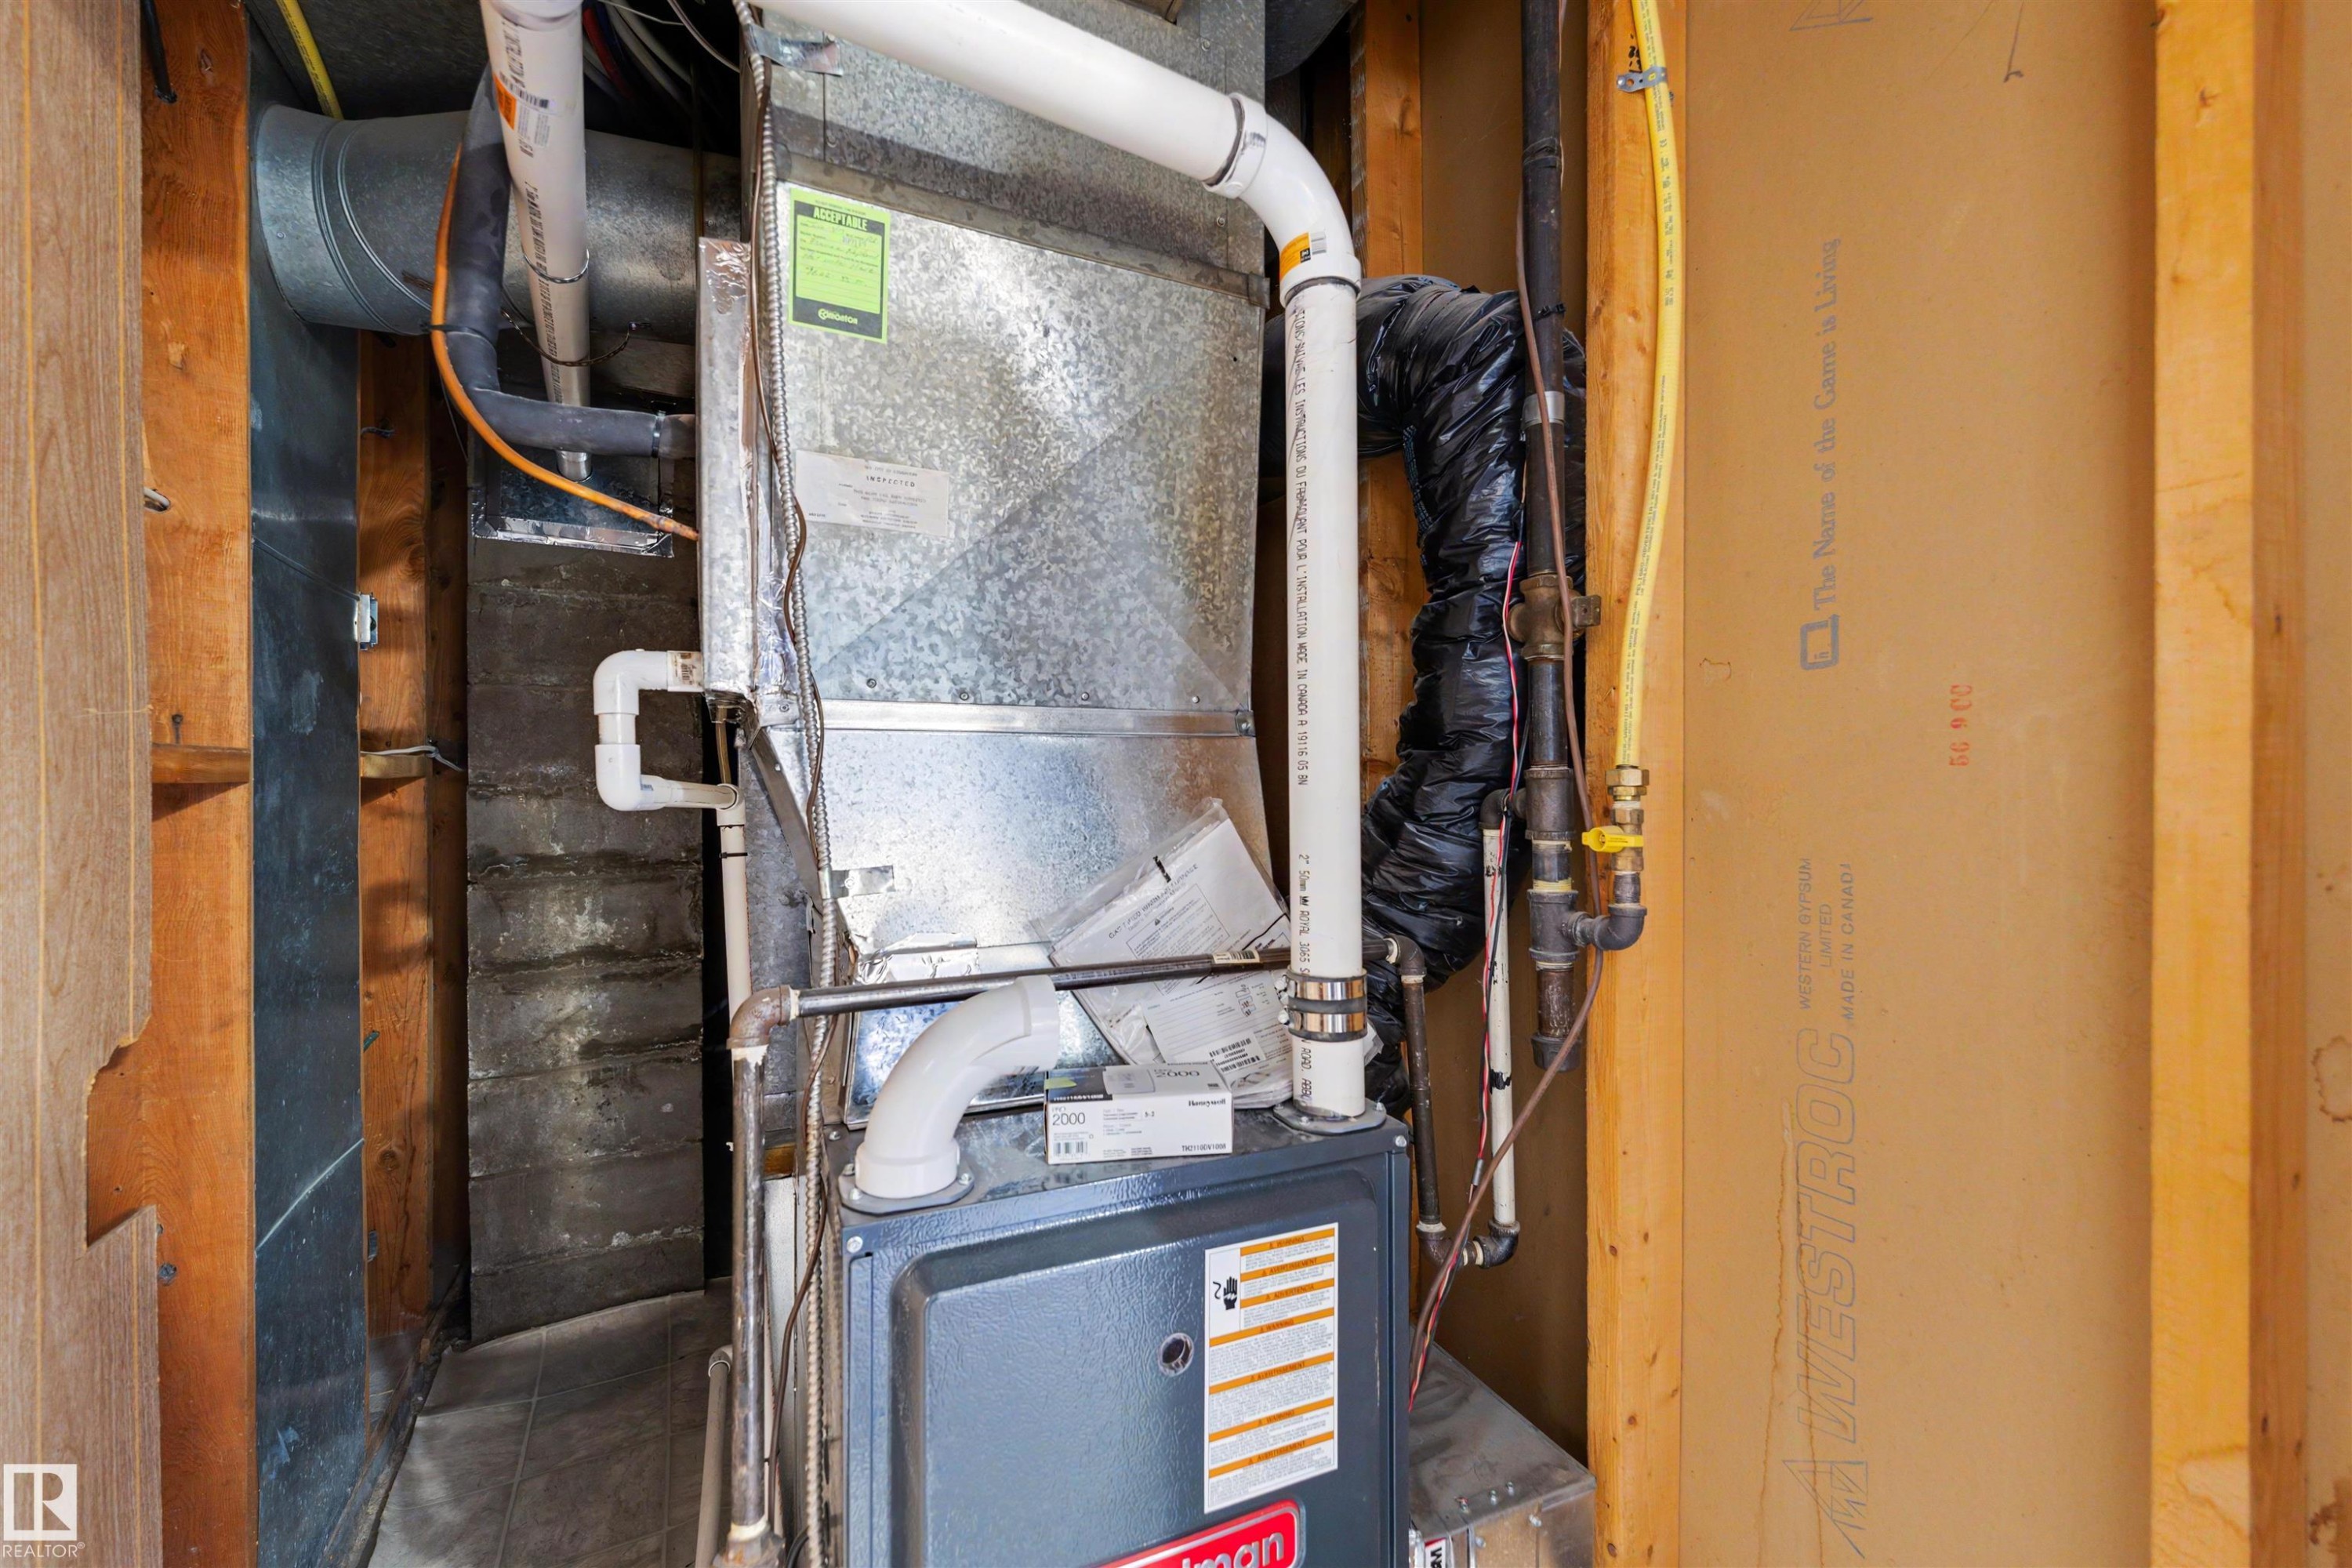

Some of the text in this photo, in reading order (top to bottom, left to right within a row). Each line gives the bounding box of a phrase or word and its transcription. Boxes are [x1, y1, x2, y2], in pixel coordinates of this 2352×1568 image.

[812, 207, 868, 230] ACCEPTABLE
[1295, 398, 1307, 463] INSTRUCTIONS
[1813, 239, 1841, 611] The Name of the Game is Living
[866, 475, 916, 488] INSPECTED
[1296, 466, 1307, 478] DU
[1296, 539, 1308, 560] POUR
[1296, 565, 1308, 639] L'INSTALLATION
[1296, 642, 1308, 664] MADE
[1297, 670, 1308, 680] IN
[1297, 684, 1308, 715] CANADA
[1298, 731, 1308, 757] 19116
[1298, 760, 1308, 771] 05
[1299, 910, 1310, 935] ROYAL
[1798, 858, 1812, 1010] WESTERN GYPSUM
[1819, 903, 1832, 967] LIMITED
[1840, 863, 1855, 1020] MADE IN CANADA
[1300, 942, 1310, 963] 3065
[1189, 1098, 1226, 1107] Honeywell
[1052, 1112, 1086, 1126] 2000
[1795, 1027, 1857, 1443] WESTROC
